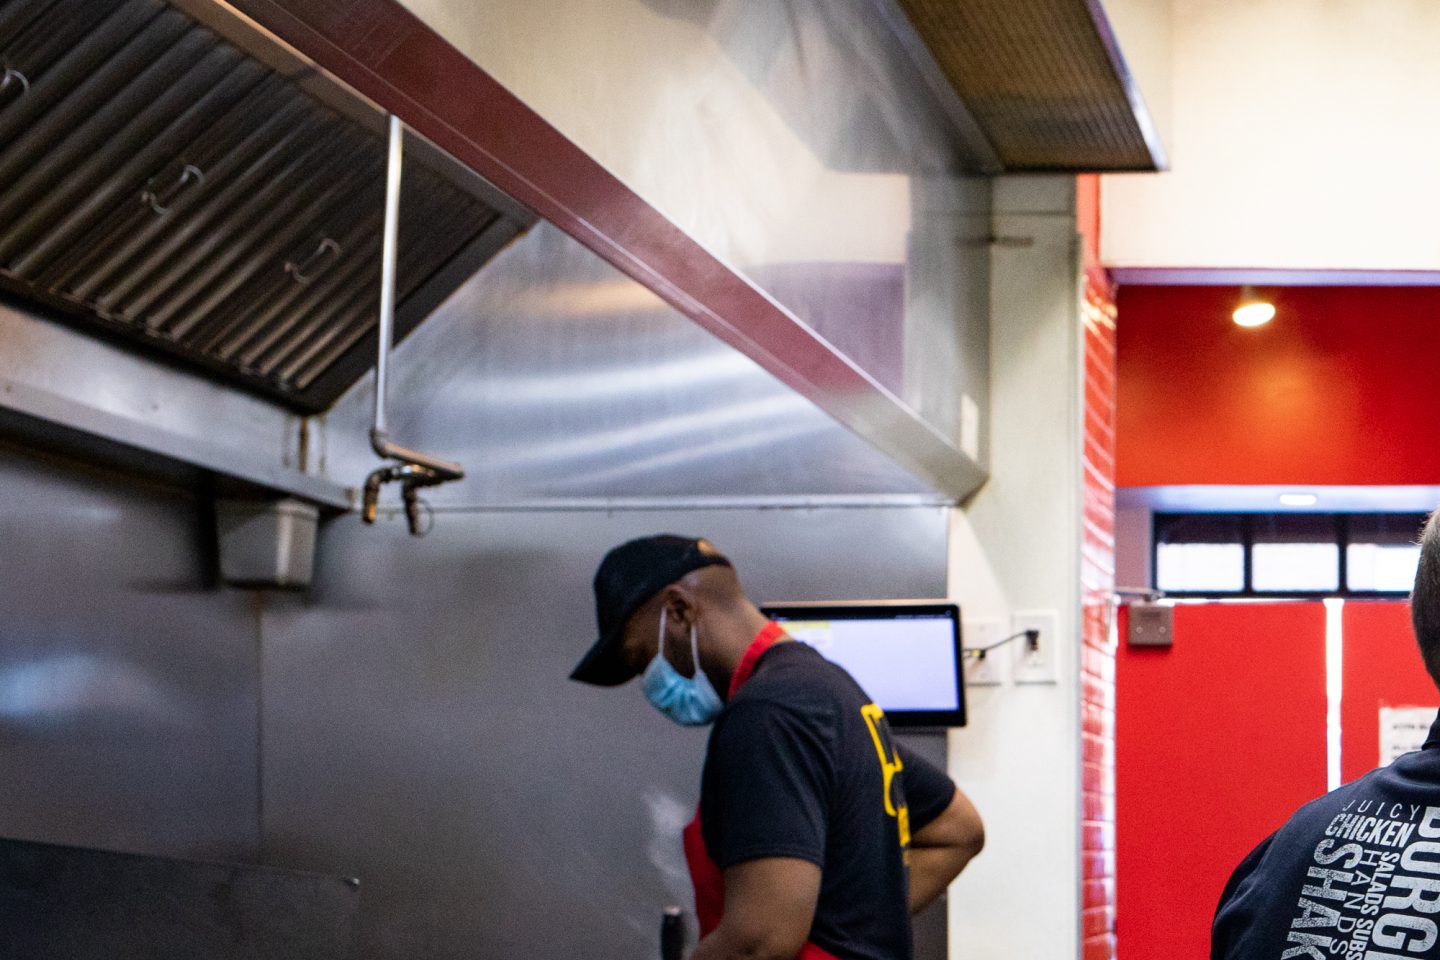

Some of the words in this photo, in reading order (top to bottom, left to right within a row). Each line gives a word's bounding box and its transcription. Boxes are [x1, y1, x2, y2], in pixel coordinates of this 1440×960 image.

[1342, 799, 1421, 821] JUICY
[1325, 813, 1416, 848] CHICKEN
[1361, 851, 1400, 915] SALADS
